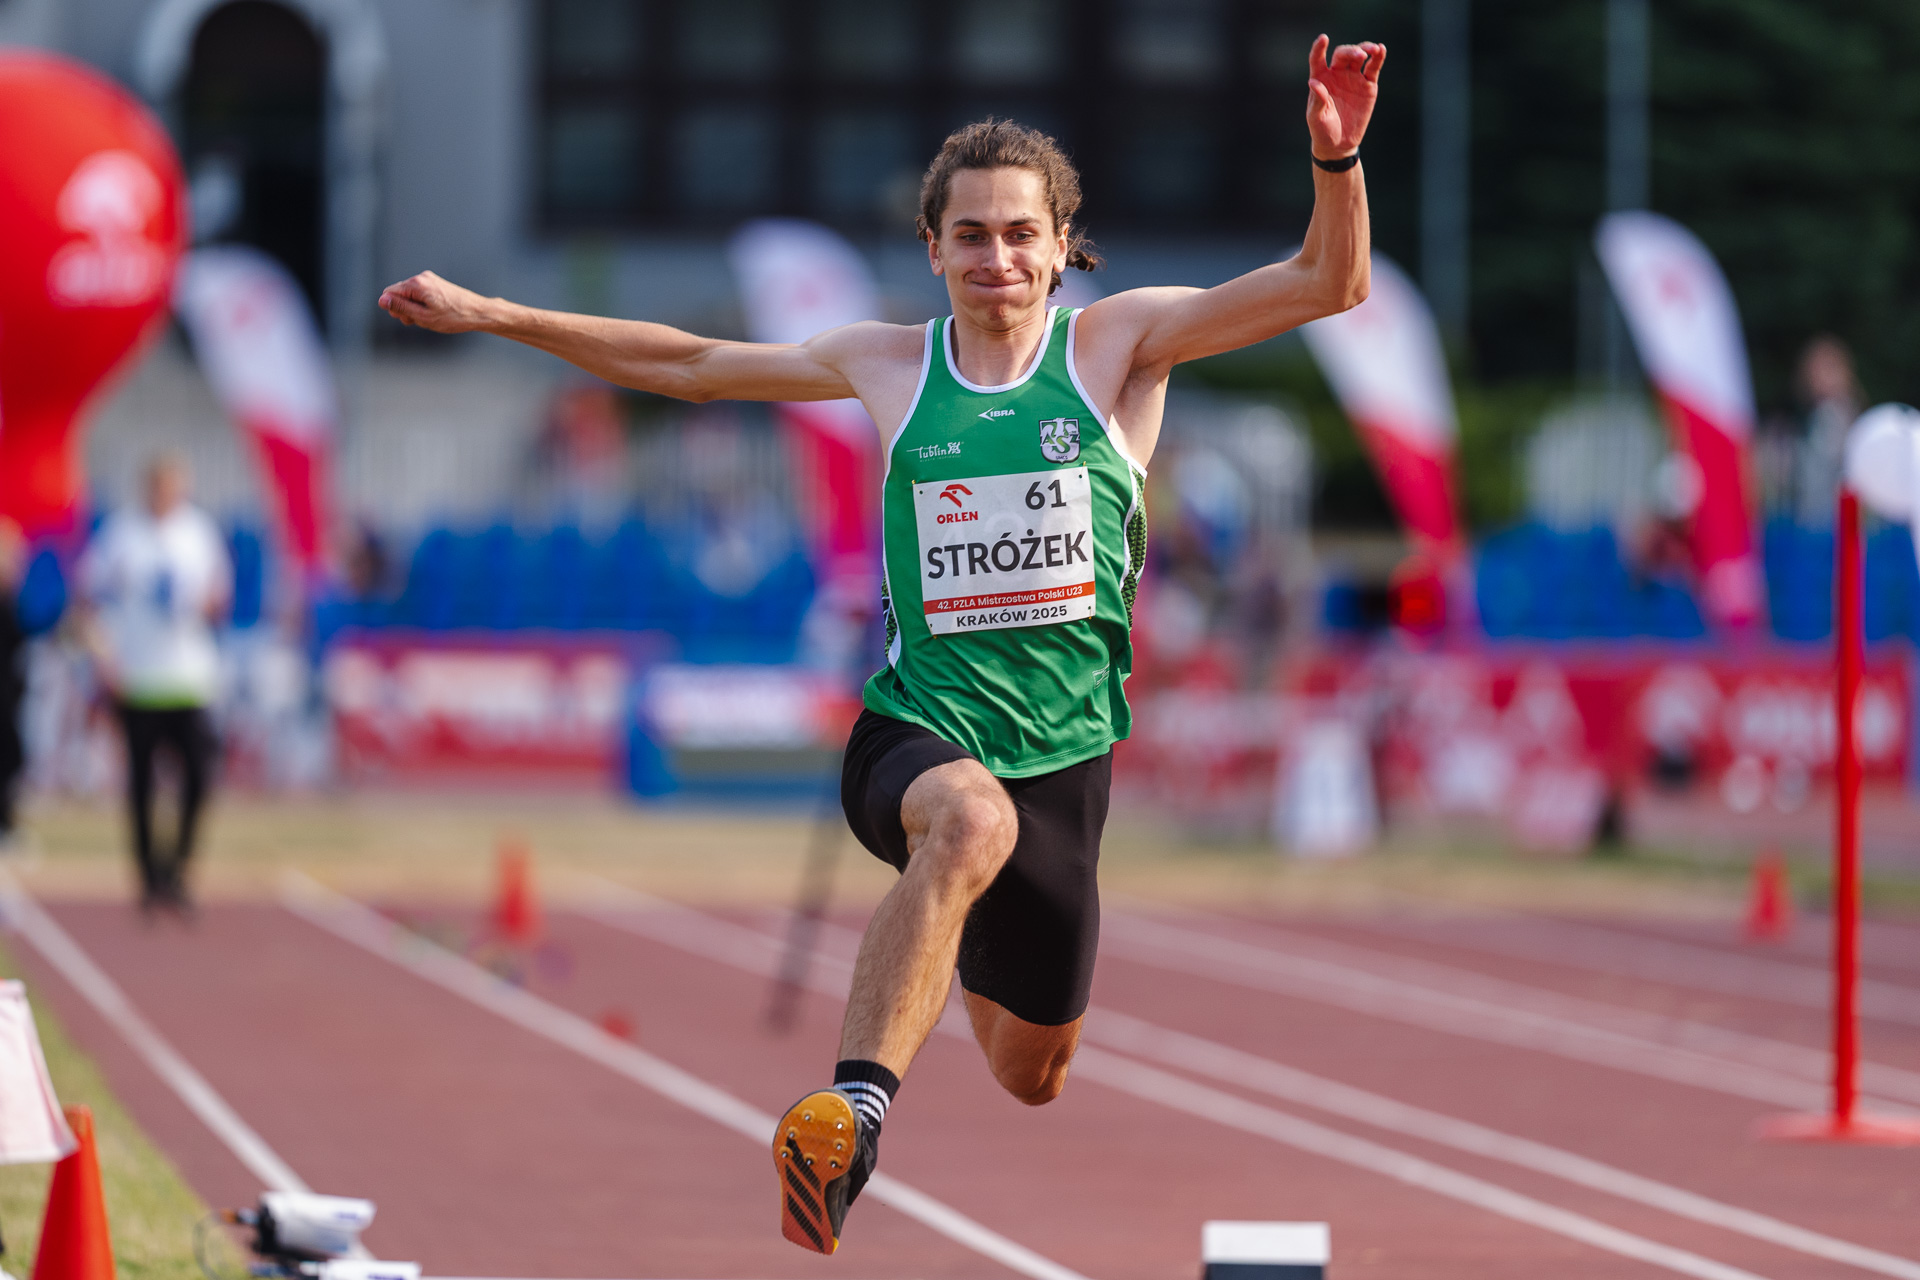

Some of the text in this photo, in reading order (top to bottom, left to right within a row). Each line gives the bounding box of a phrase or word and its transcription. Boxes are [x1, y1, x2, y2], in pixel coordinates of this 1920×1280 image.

[1025, 479, 1067, 510] 61
[936, 511, 979, 525] ORLEN
[927, 528, 1089, 580] STRÓŻEK
[935, 585, 1083, 610] 42. PZLA Mistrzostwa Polski U23
[956, 606, 1068, 628] KRAKÓW 2025
